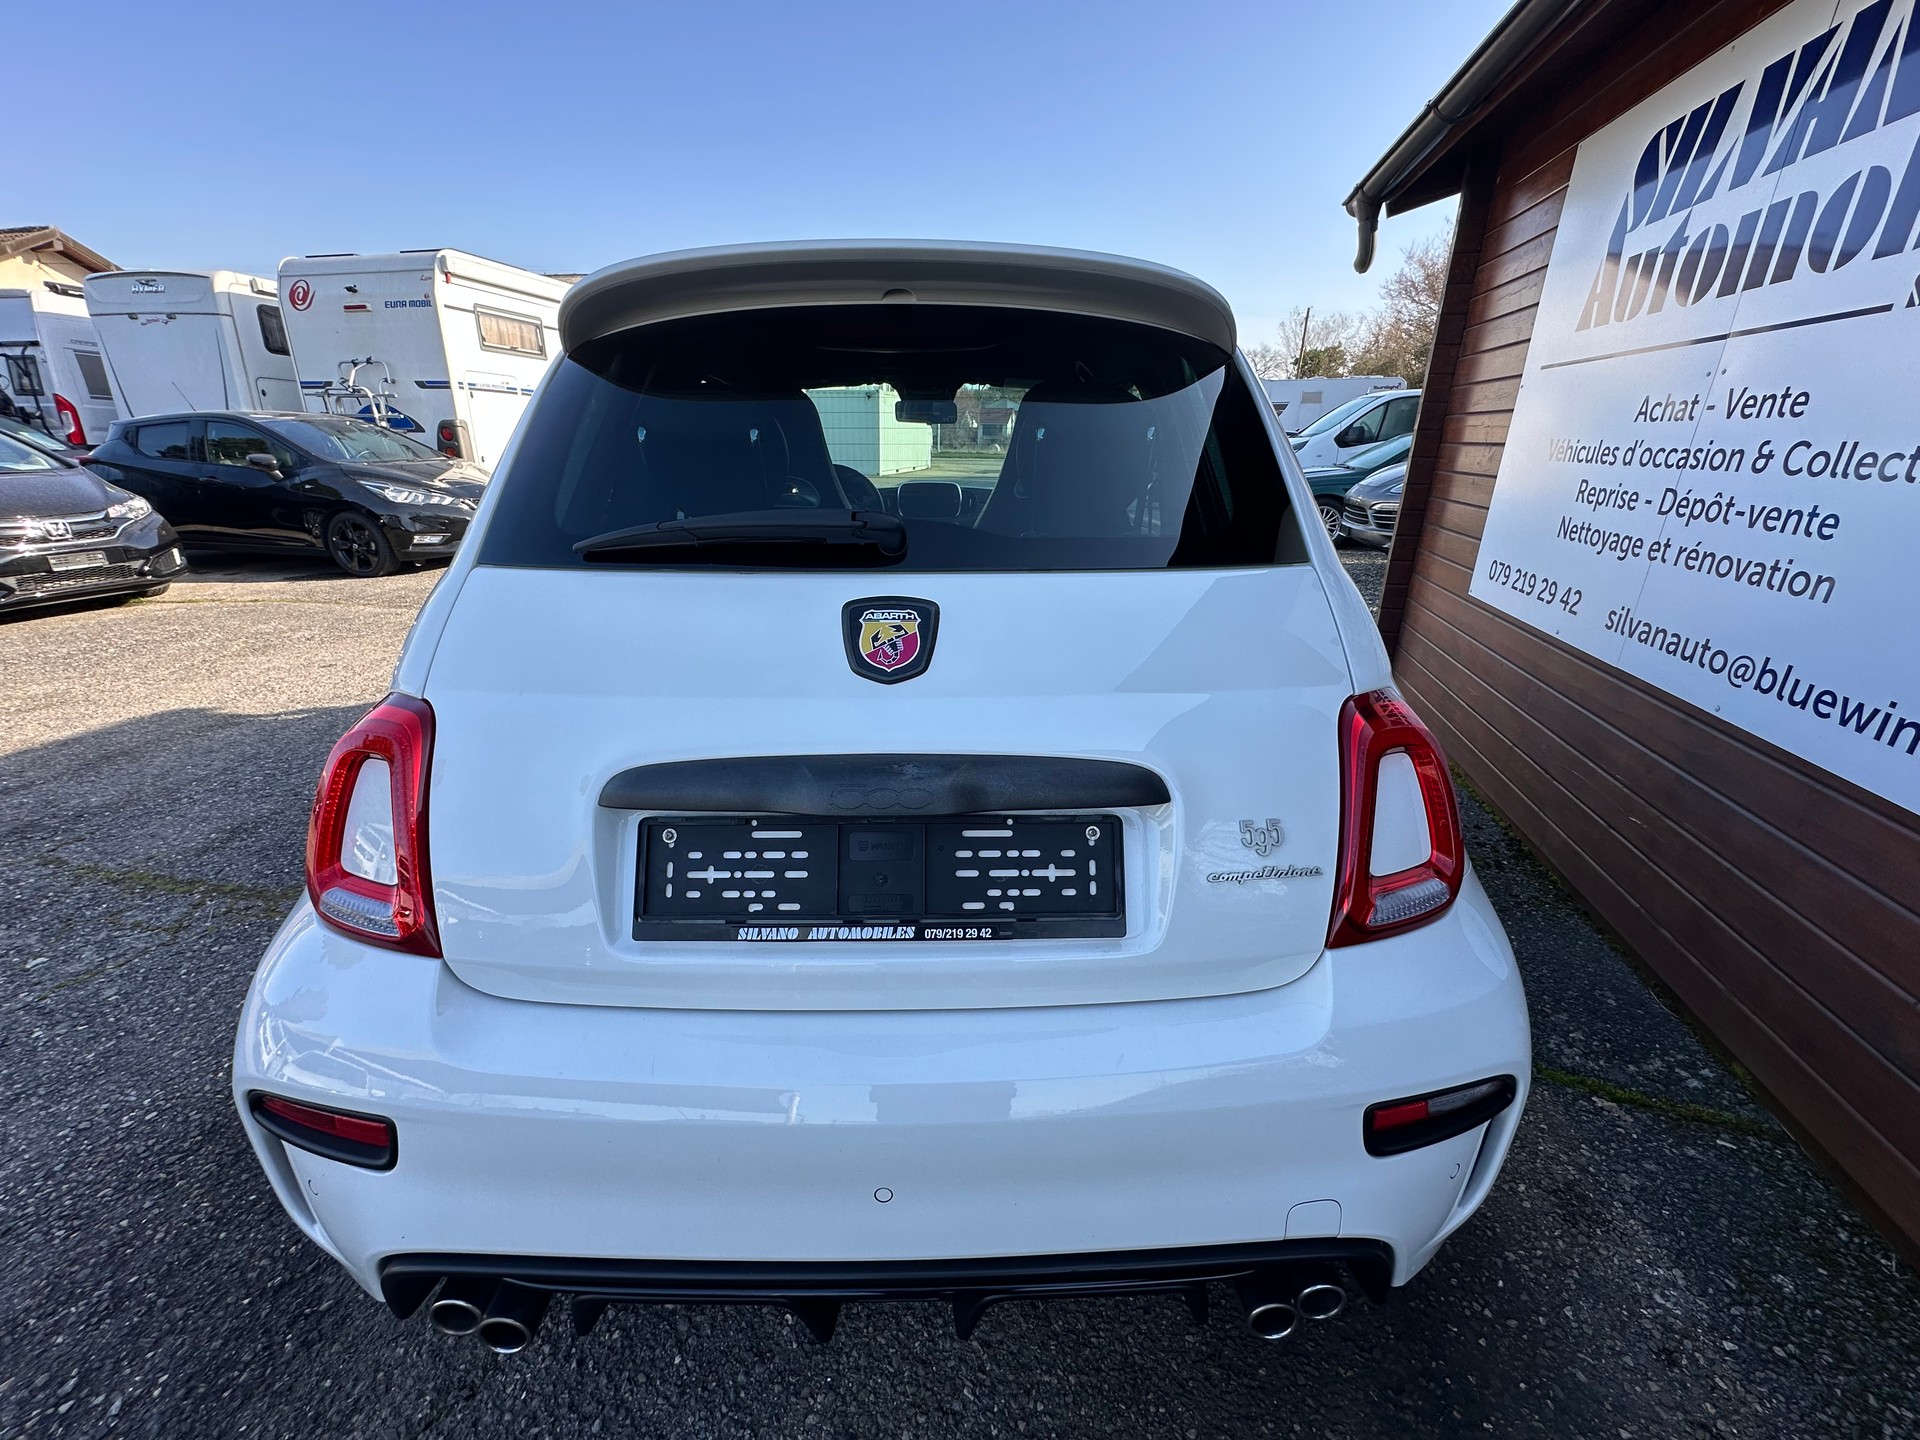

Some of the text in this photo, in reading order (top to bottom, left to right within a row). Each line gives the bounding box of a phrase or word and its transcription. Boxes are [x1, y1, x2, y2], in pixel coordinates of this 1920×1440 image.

[385, 299, 433, 309] EURA MOBIL
[1633, 393, 1700, 422] Achat
[1726, 386, 1810, 419] Vente
[1549, 439, 1620, 466] Véhicules
[1622, 439, 1745, 473] d'occasion
[1751, 440, 1775, 474] &
[1575, 479, 1639, 512] Reprise
[1657, 487, 1840, 541] Dépôt-vente
[1557, 515, 1836, 604] Nettoyage et rénovation
[1488, 560, 1583, 616] 079 219 29 42
[865, 612, 915, 620] ABARTH
[1605, 606, 1920, 756] silvanauto@bluewin
[829, 783, 935, 810] 500
[1239, 818, 1285, 857] 595
[1206, 864, 1323, 885] competizione
[737, 926, 992, 940] SILVANO AUTOMOBILES 079/219 29 42
